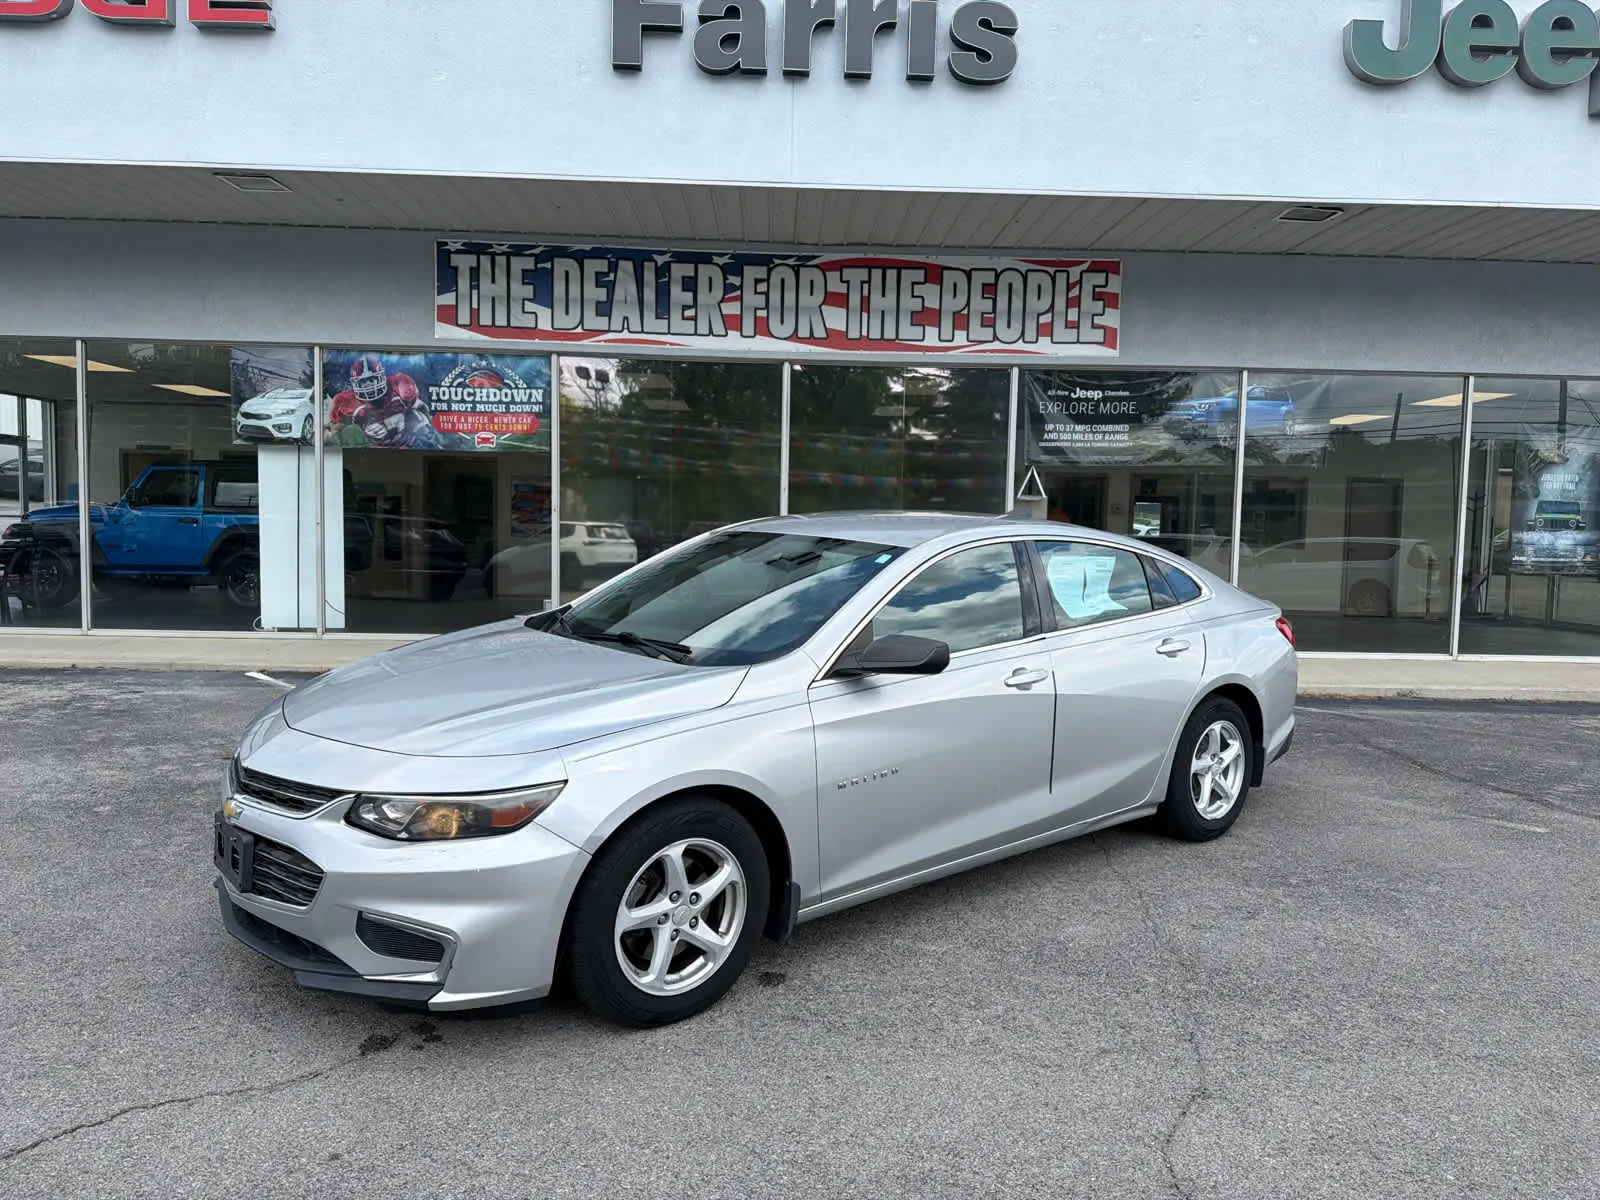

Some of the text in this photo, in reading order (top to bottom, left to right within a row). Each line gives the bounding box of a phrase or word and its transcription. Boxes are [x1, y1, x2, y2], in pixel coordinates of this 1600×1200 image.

[611, 0, 1019, 86] Farris
[1343, 0, 1600, 118] Jee
[450, 253, 1109, 345] THE DEALER FOR THE PEOPLE
[429, 386, 544, 402] TOUCHDOWN
[1070, 386, 1103, 400] Jeep
[431, 402, 543, 413] FOR NOT MUCH DOWN!
[1039, 401, 1140, 415] EXPLORE MORE.
[439, 415, 458, 423] DRIVE
[518, 416, 532, 424] CAR
[1044, 423, 1130, 432] UP TO 37 MPG COMBINED
[1043, 432, 1059, 440] AND
[1072, 433, 1093, 441] MILES
[1105, 433, 1129, 441] RANGE
